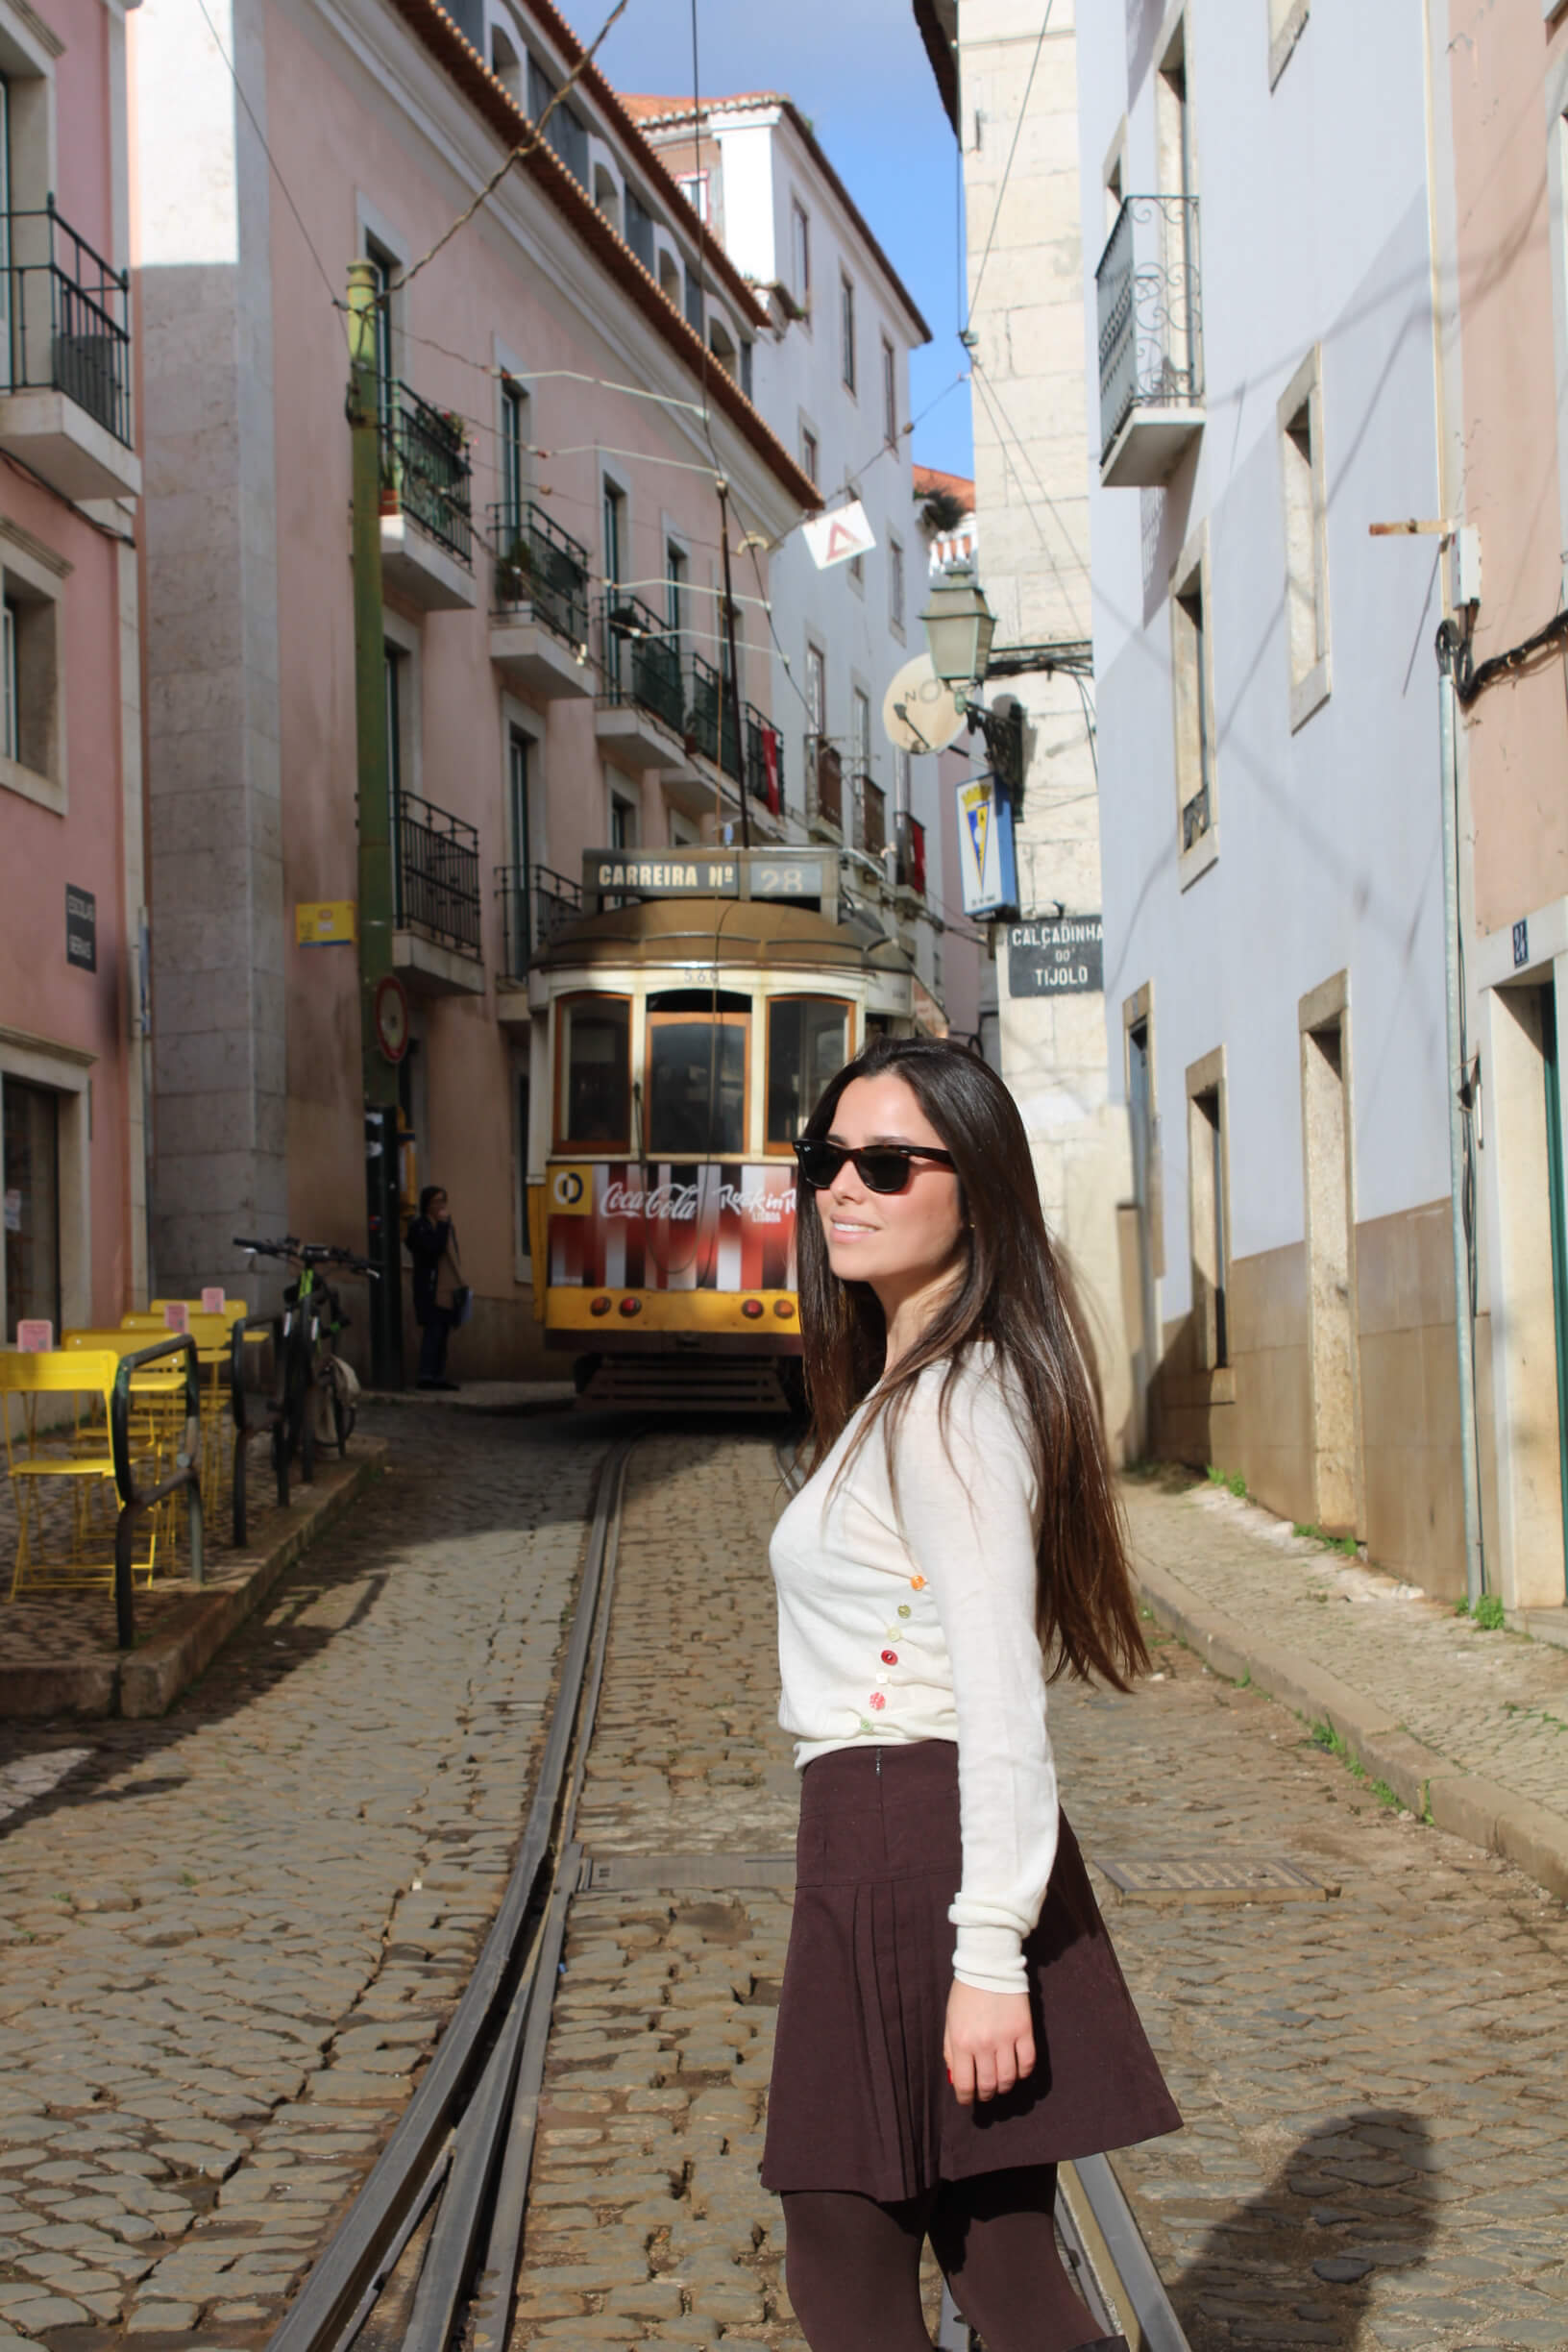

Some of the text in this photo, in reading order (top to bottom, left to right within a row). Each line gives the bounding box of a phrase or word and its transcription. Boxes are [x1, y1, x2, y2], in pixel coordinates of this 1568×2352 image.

[599, 864, 698, 887] CARREIRA
[760, 868, 804, 893] 28
[1012, 922, 1103, 949] CALÇADINHA
[1055, 949, 1070, 963] DO
[1035, 965, 1089, 986] TIJOLO
